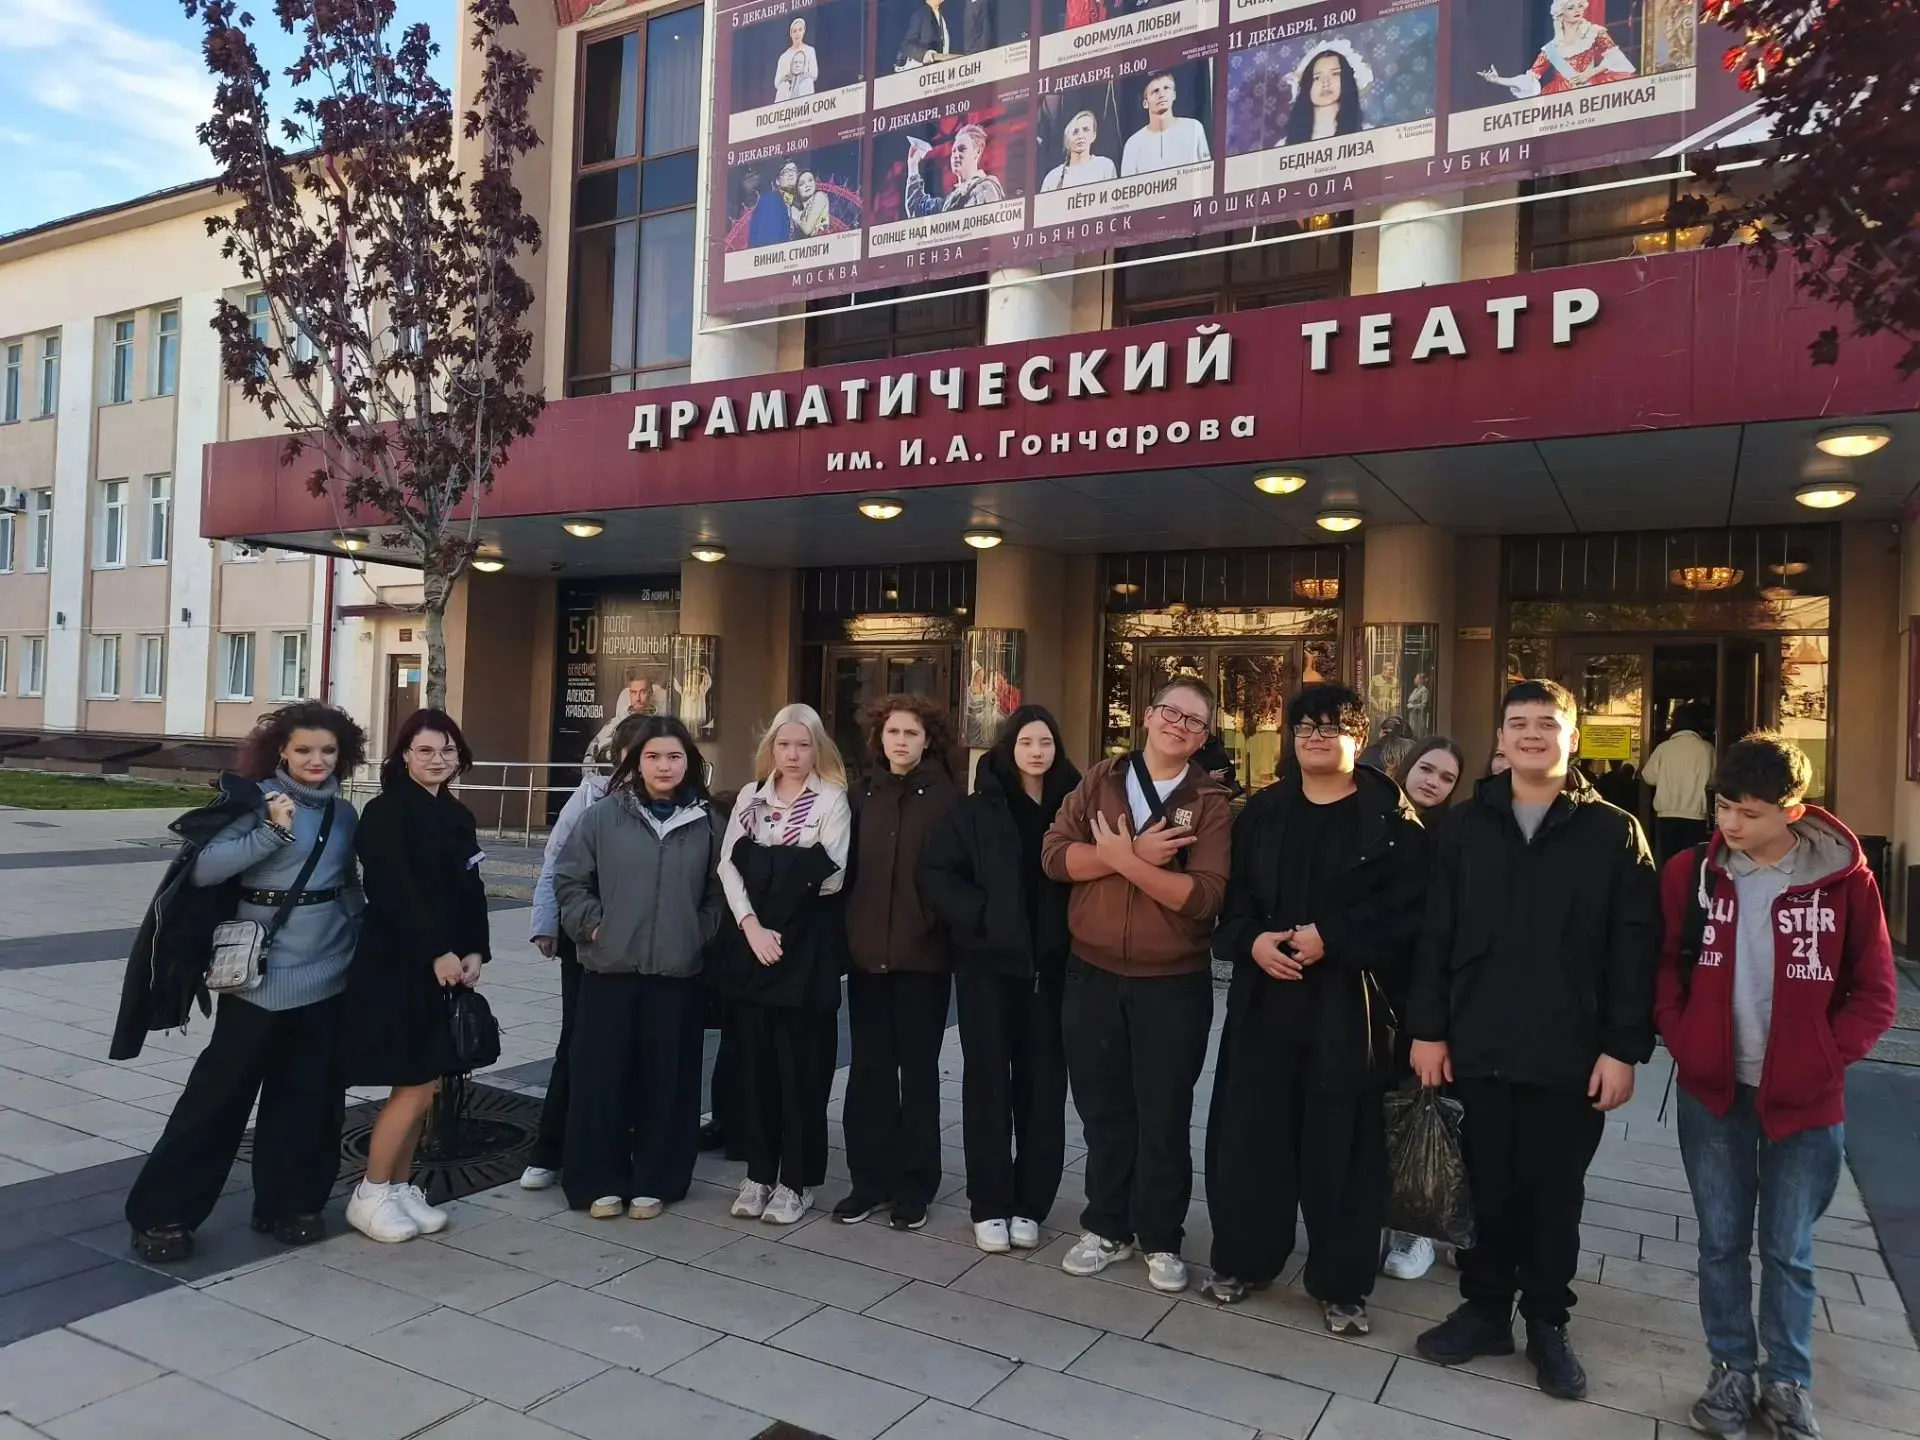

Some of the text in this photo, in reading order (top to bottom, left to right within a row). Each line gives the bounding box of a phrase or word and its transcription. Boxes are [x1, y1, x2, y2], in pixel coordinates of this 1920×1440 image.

[732, 13, 739, 27] 5
[742, 3, 788, 26] ДЕКАБРЯ,
[1073, 11, 1181, 48] ФОРМУЛА ЛЮБВИ
[1228, 8, 1356, 50] 11 ДЕКАБРЯ, 18.00
[919, 70, 945, 88] ОТЕЦ
[948, 67, 955, 81] И
[958, 61, 981, 77] СЫН
[1037, 58, 1147, 94] 11 ДЕКАБРЯ, 18.00
[756, 102, 810, 127] ПОСЛЕДНИЙ
[812, 97, 837, 114] СРОК
[872, 100, 970, 132] 10 ДЕКАБРЯ, 18.00
[1483, 85, 1656, 132] ЕКАТЕРИНА ВЕЛИКАЯ
[728, 137, 808, 166] 9 ДЕКАБРЯ, 18.00
[1280, 139, 1374, 170] БЕДНАЯ ЛИЗА
[1067, 177, 1177, 210] ПЁТР И ФЕВРОНИЯ
[792, 265, 858, 287] МОСКВА
[907, 246, 963, 268] ПЕНЗА
[1012, 216, 1132, 249] УЛЬЯНОВСК
[1193, 176, 1353, 218] ЙОШКАР-ОЛА
[1427, 144, 1530, 177] ГУБКИН
[872, 230, 906, 246] СОЛНЦЕ
[908, 226, 927, 240] НАД
[930, 220, 960, 235] МОИМ
[963, 208, 1022, 230] ДОНБАССОМ
[753, 243, 829, 267] ВИНИЛ. СТИЛЯГИ
[628, 288, 1600, 451] ДРАМАТИЧЕСКИЙ ТЕАТР
[827, 450, 884, 472] им.
[999, 415, 1256, 458] Гончарова
[568, 615, 598, 655] 5:0
[602, 633, 668, 655] НОРМАЛЬНЫЙ
[566, 689, 595, 702] АЛЕКСЕЯ
[1777, 907, 1836, 934] STER
[1786, 963, 1834, 981] ORNIA
